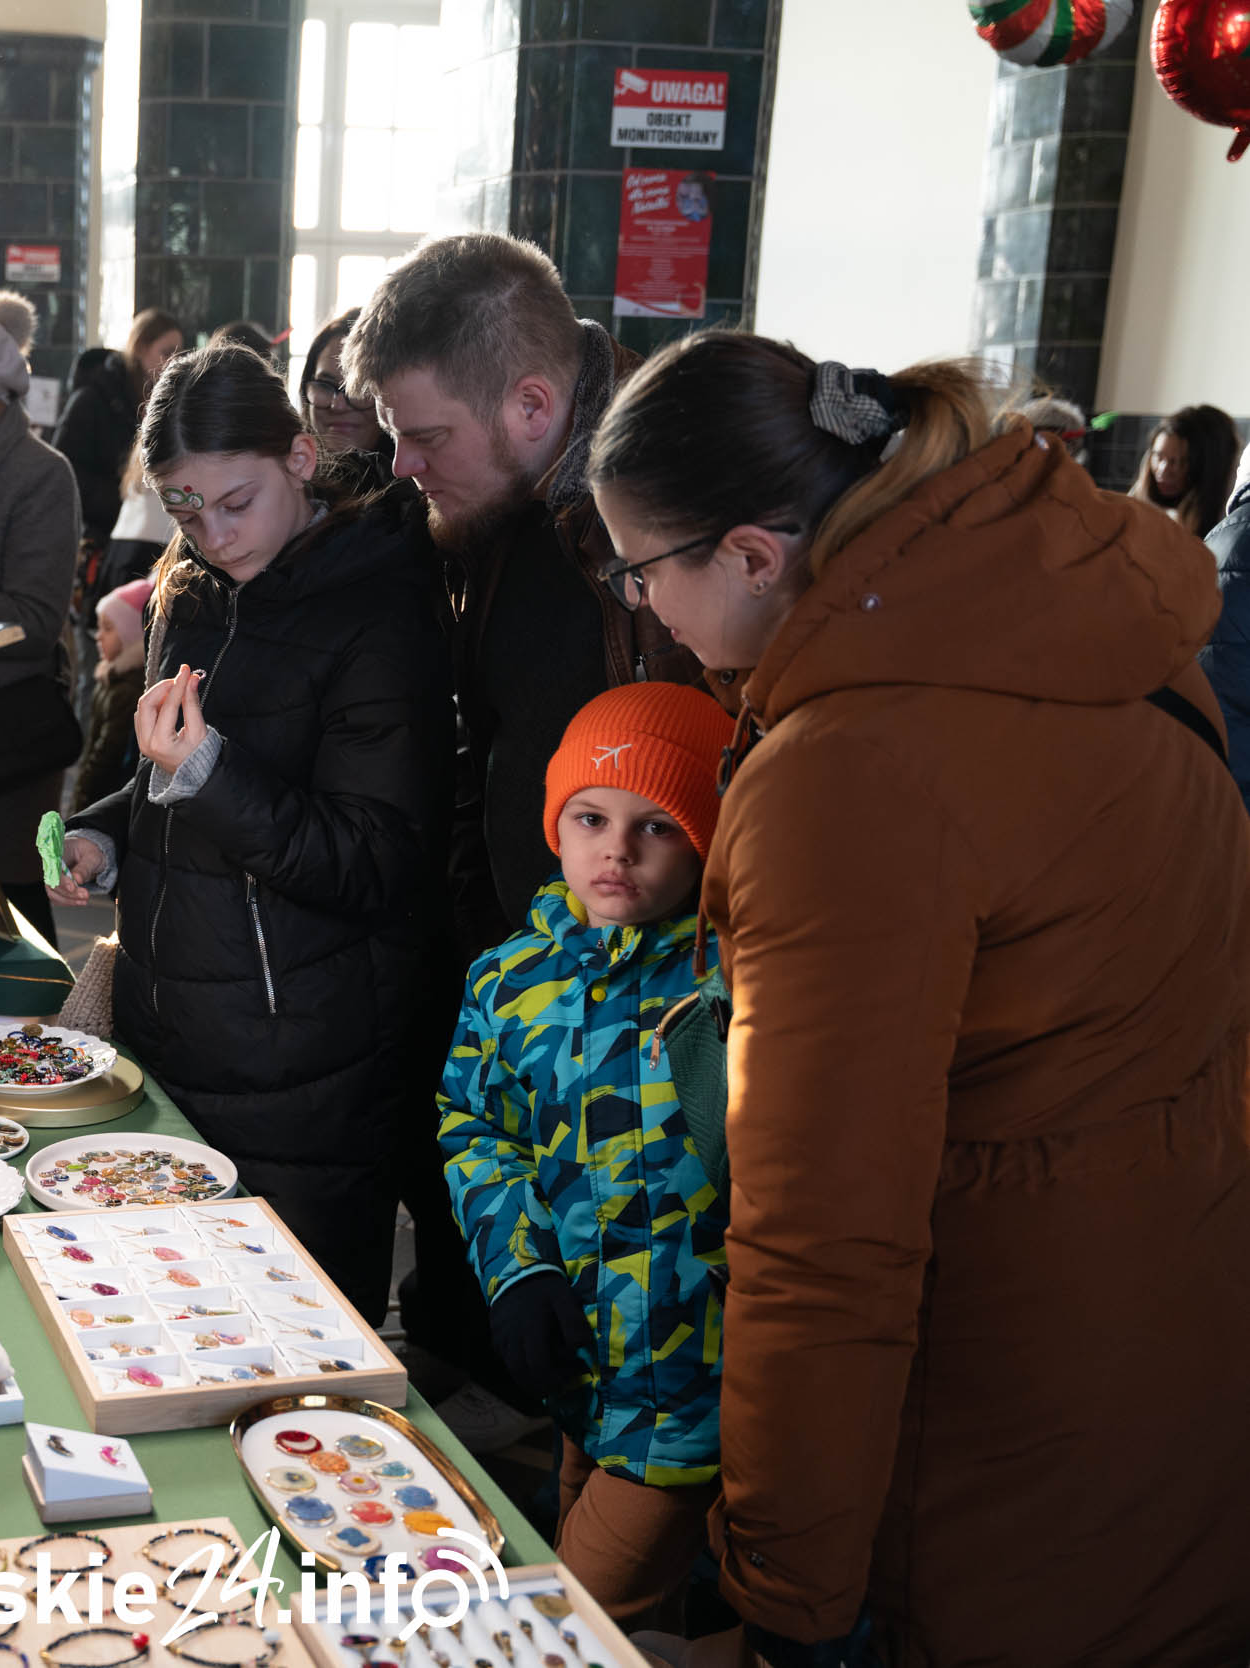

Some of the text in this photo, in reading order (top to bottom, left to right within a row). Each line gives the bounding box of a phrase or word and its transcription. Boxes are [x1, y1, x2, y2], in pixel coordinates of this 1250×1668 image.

[651, 80, 725, 105] UWAGA!
[646, 112, 692, 127] OBIEKT
[616, 127, 719, 145] MONITOROWANY
